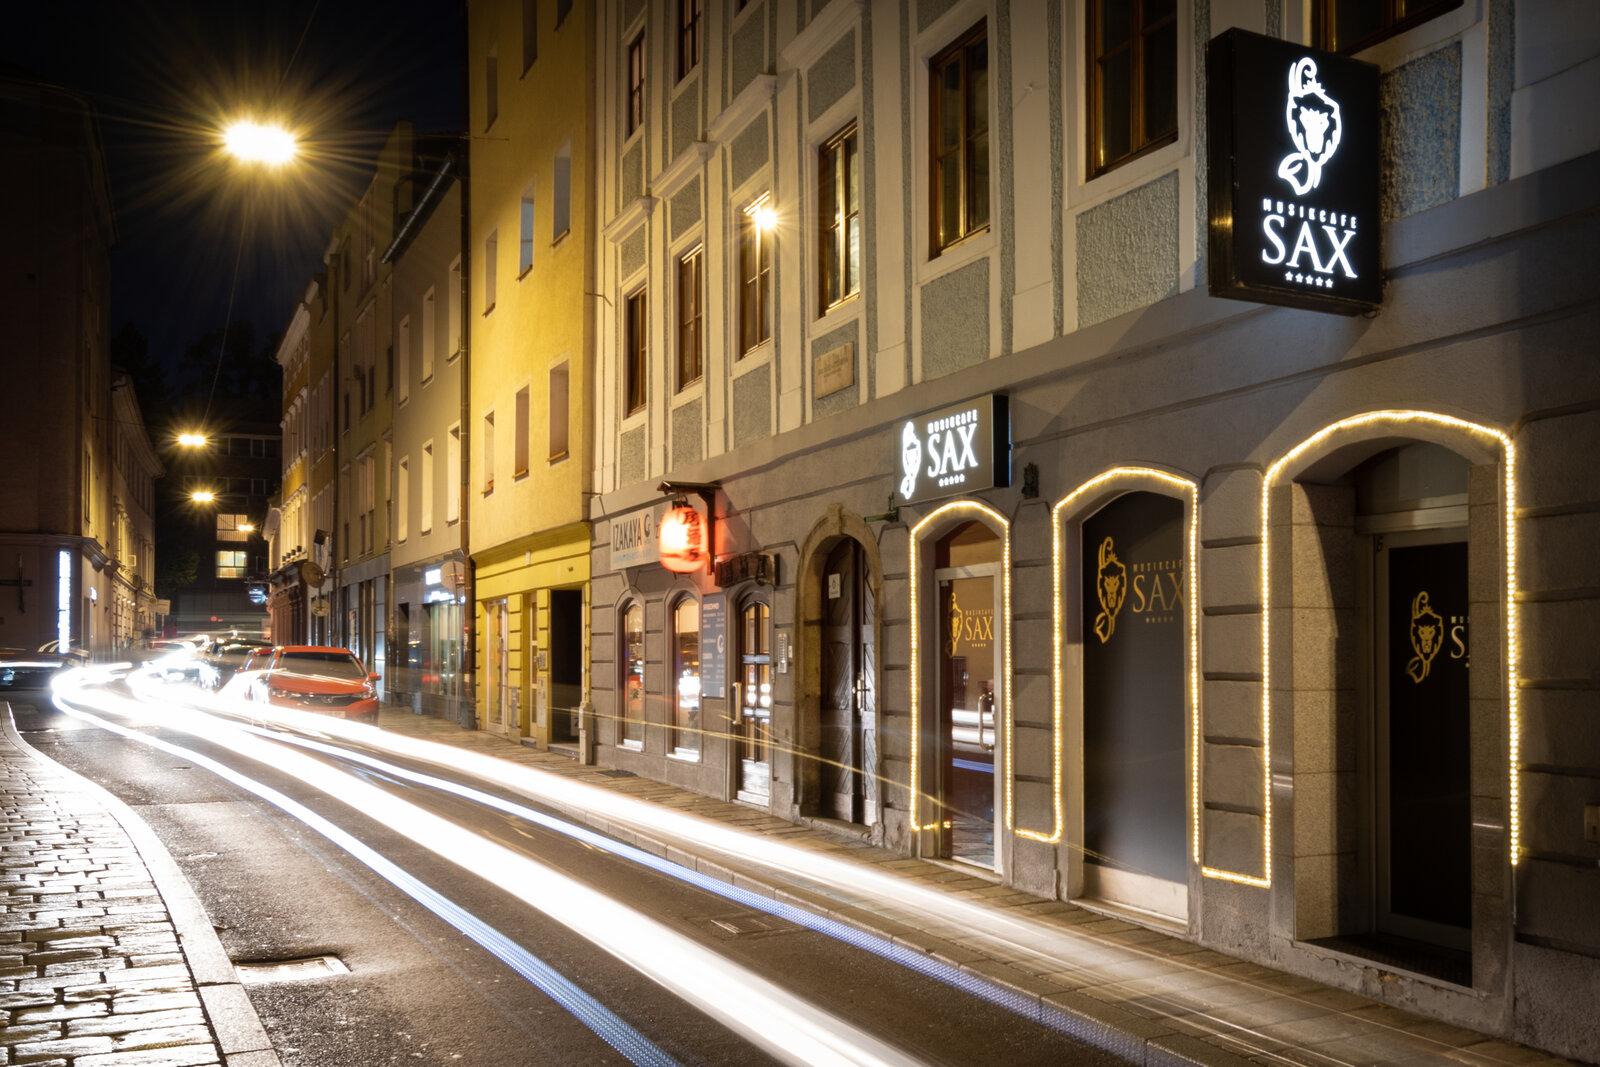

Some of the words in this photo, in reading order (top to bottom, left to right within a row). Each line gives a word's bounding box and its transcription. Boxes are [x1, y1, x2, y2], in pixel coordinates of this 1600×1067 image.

[1263, 198, 1357, 229] MUSIKCAFE
[1262, 214, 1358, 278] SAX
[927, 409, 978, 434] MUSIKCAFE
[927, 423, 978, 477] SAX
[612, 518, 643, 552] IZAKAYA
[644, 513, 651, 538] G
[1132, 572, 1184, 613] SAX
[965, 616, 994, 641] SAX
